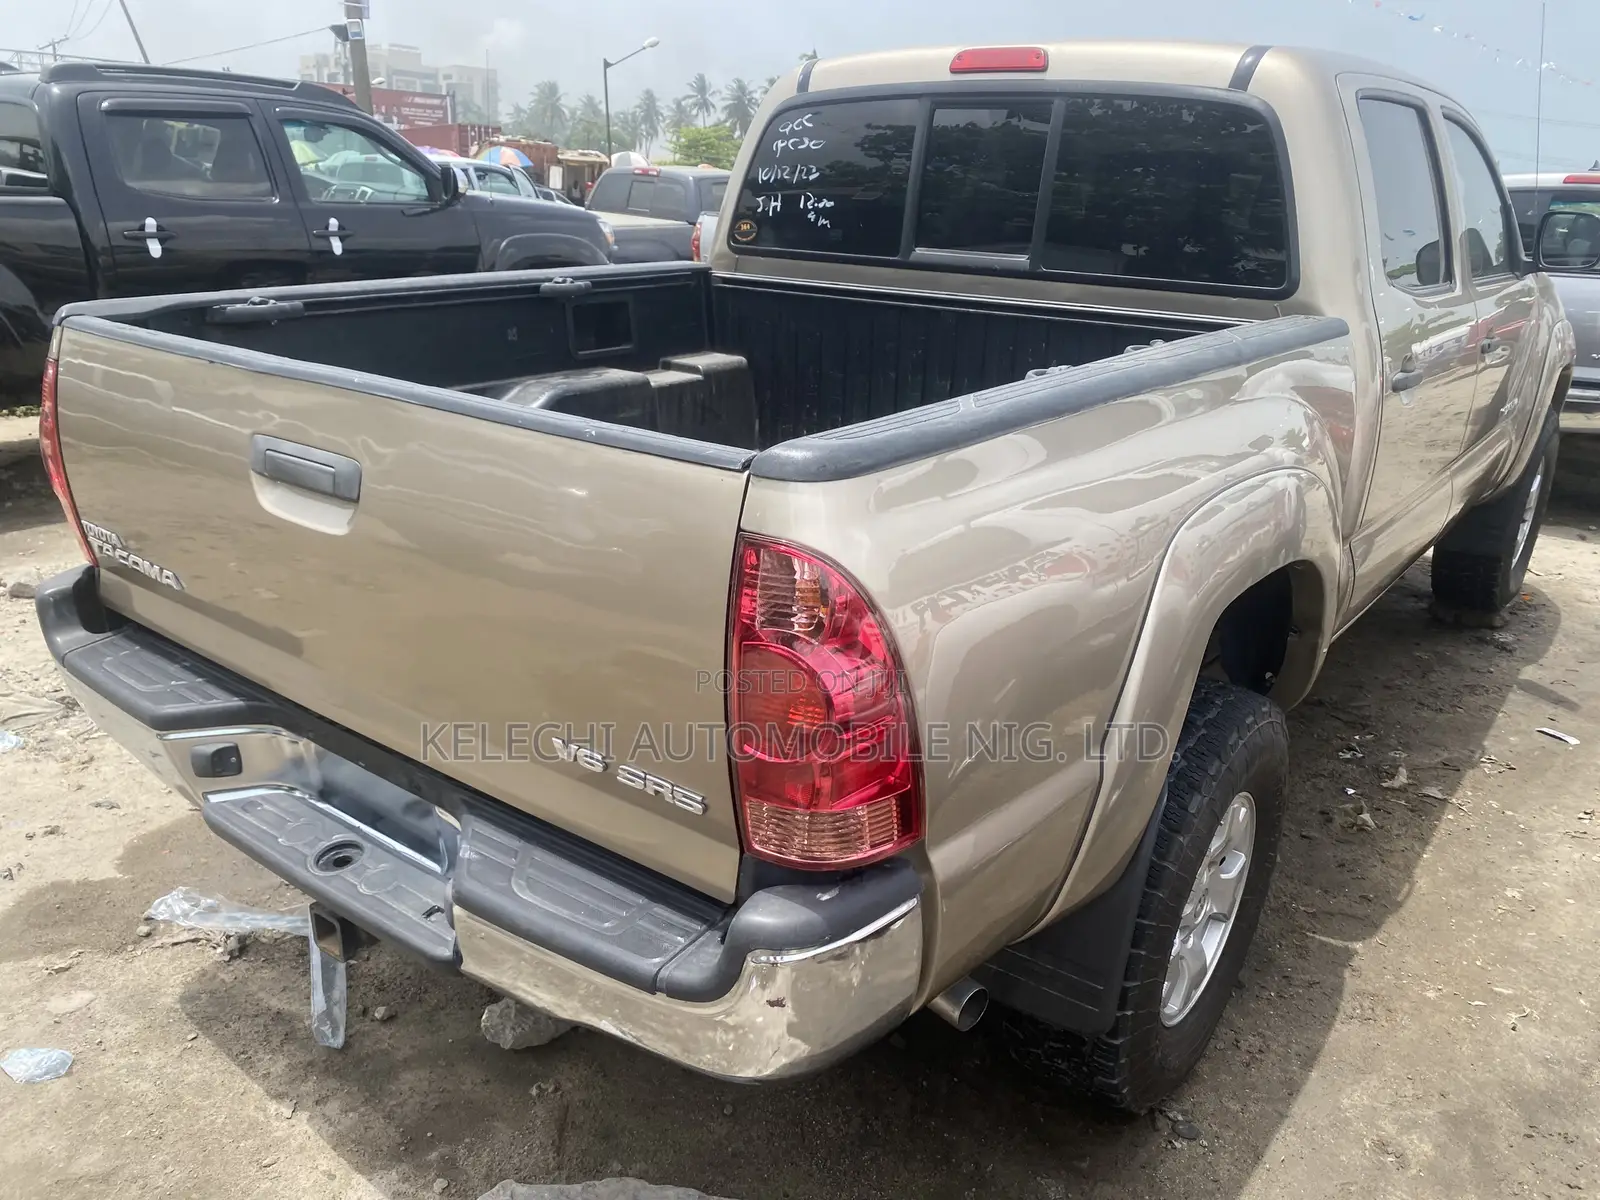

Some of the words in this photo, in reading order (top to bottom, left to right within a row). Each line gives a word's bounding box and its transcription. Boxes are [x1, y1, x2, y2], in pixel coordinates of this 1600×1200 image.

[80, 519, 124, 549] TOYOTA
[88, 536, 184, 591] TACOMA
[551, 736, 608, 773] V6
[616, 764, 708, 816] SR5
